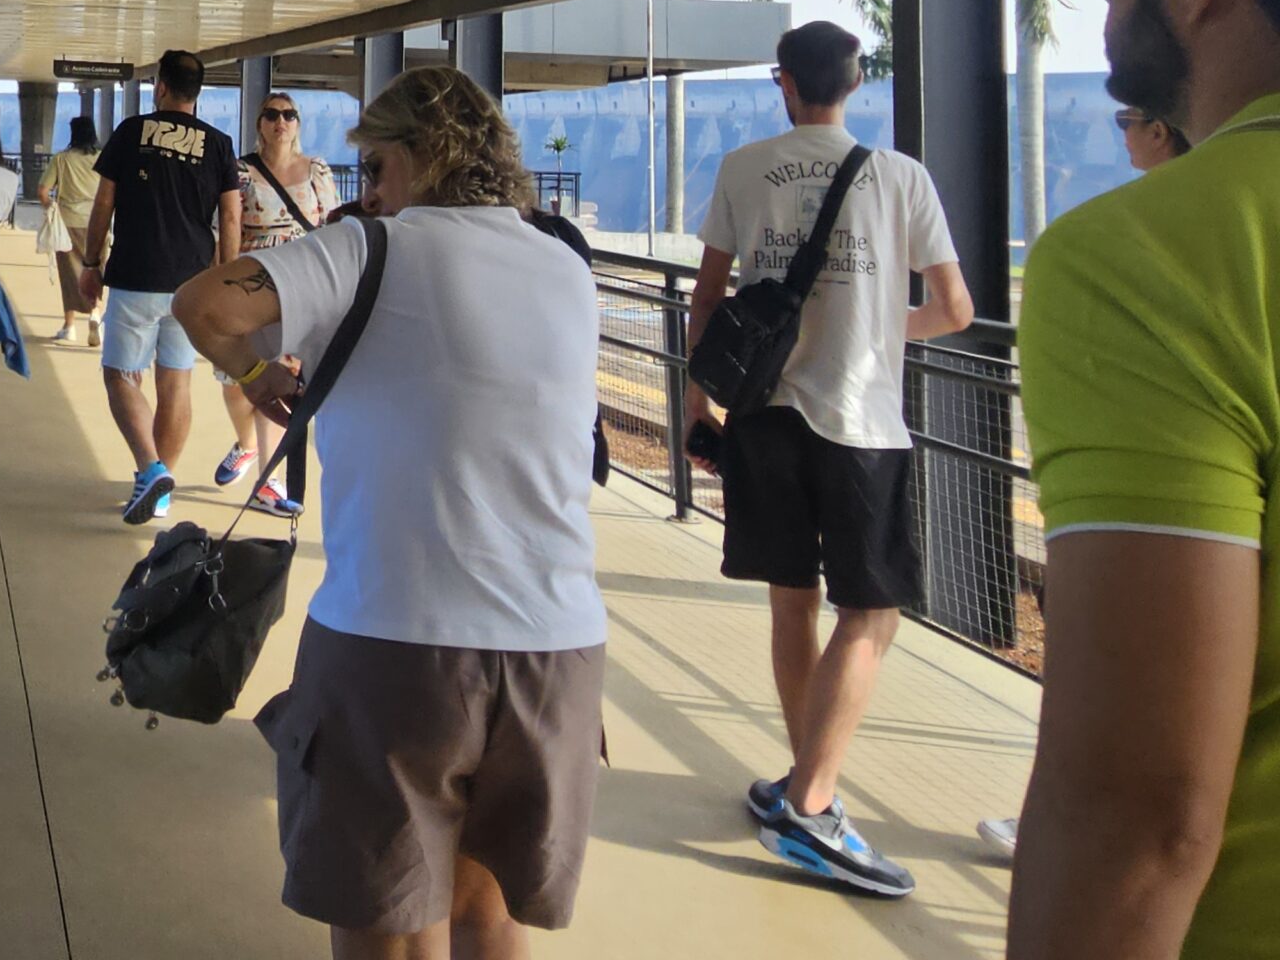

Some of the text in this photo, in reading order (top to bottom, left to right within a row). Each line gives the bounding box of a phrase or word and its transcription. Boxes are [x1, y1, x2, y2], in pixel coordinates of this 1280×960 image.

[764, 161, 874, 191] WELCOE
[764, 227, 809, 248] Back
[835, 229, 868, 252] The
[821, 252, 877, 276] radise
